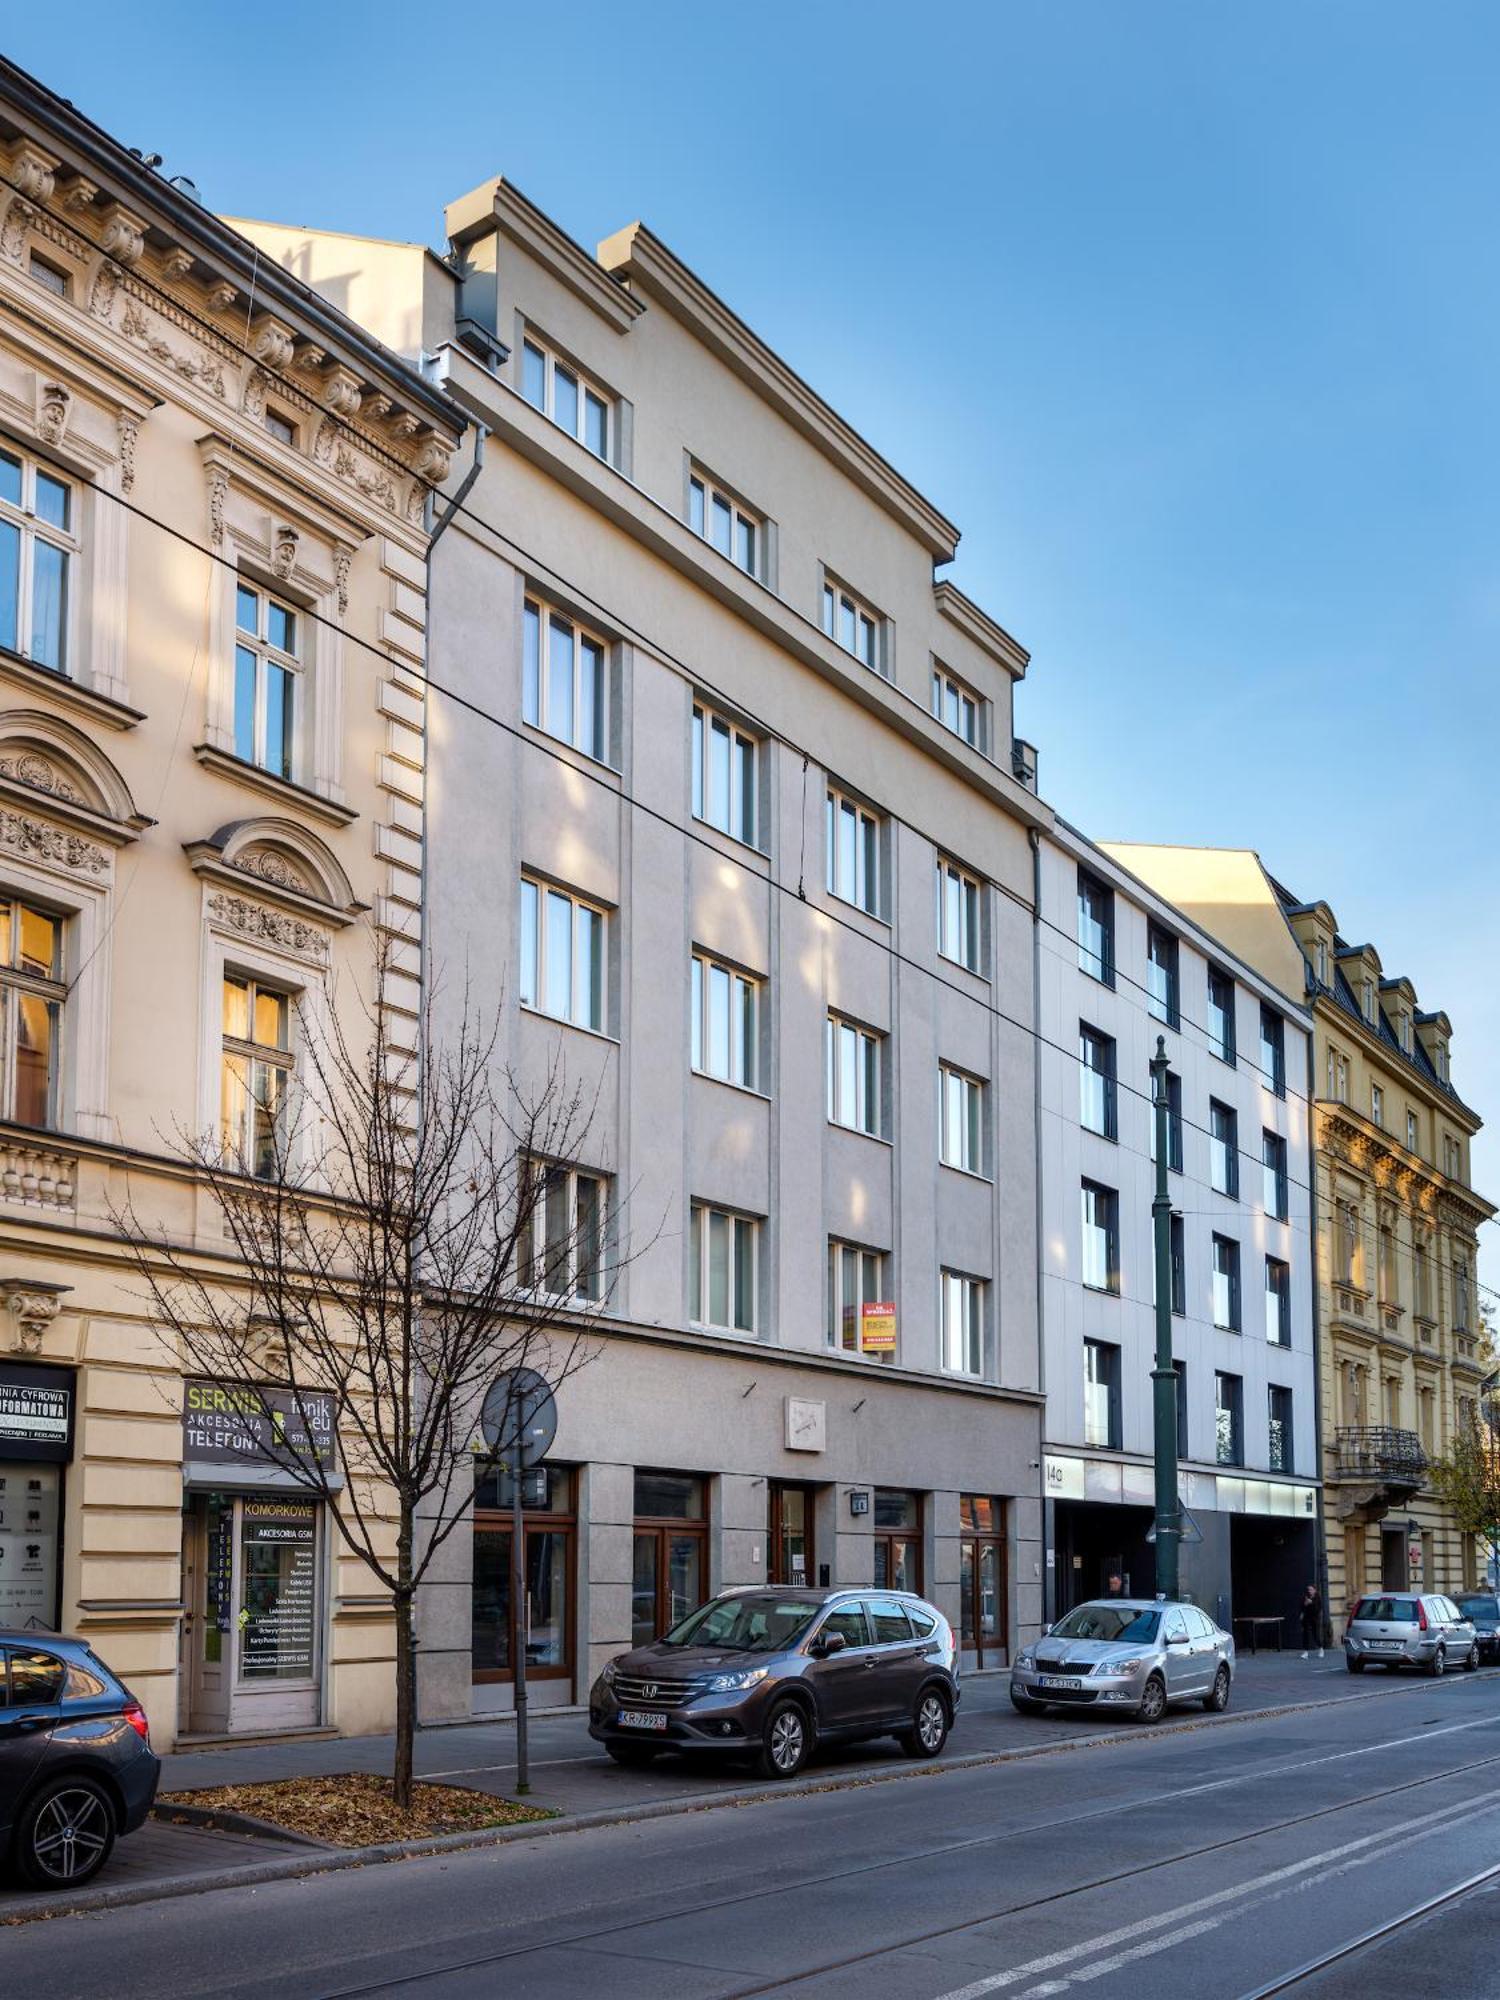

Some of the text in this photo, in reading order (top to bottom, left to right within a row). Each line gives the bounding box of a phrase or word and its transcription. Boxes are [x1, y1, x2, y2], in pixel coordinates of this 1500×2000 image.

[0, 1388, 64, 1402] NIA CYFROWA
[188, 1388, 262, 1415] SERWIS
[0, 1399, 64, 1418] FORMATOWA
[187, 1430, 261, 1450] TELEFONY
[258, 1528, 313, 1539] AKCESORIA GSM
